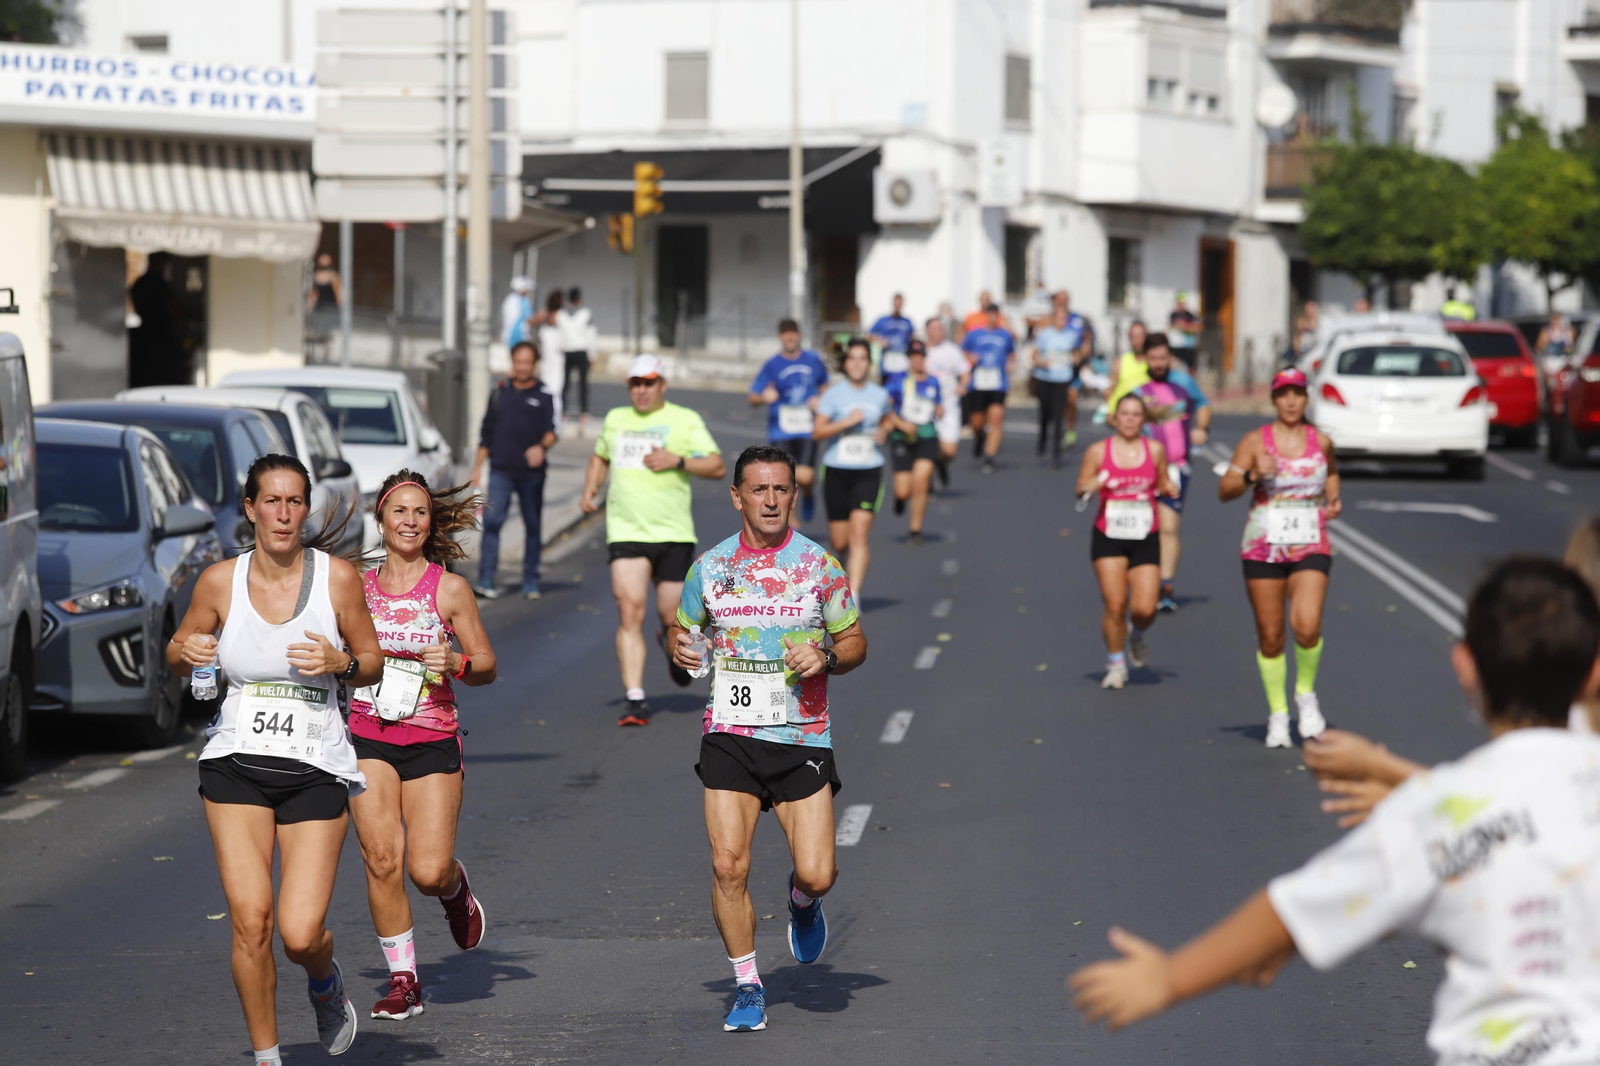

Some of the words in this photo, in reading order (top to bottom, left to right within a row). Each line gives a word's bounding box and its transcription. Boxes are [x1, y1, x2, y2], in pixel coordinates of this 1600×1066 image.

[25, 80, 177, 106] PATATAS
[190, 90, 305, 114] FRITAS
[1283, 517, 1299, 530] 24
[780, 606, 803, 617] FIT
[410, 632, 433, 643] FIT
[728, 661, 747, 671] VUELTA
[749, 662, 754, 671] A
[755, 663, 778, 673] HUELVA
[249, 685, 258, 695] 34
[259, 686, 285, 697] VUELTA
[287, 688, 293, 697] A
[294, 688, 321, 702] HUELVA
[730, 685, 751, 707] 38
[252, 711, 294, 737] 544
